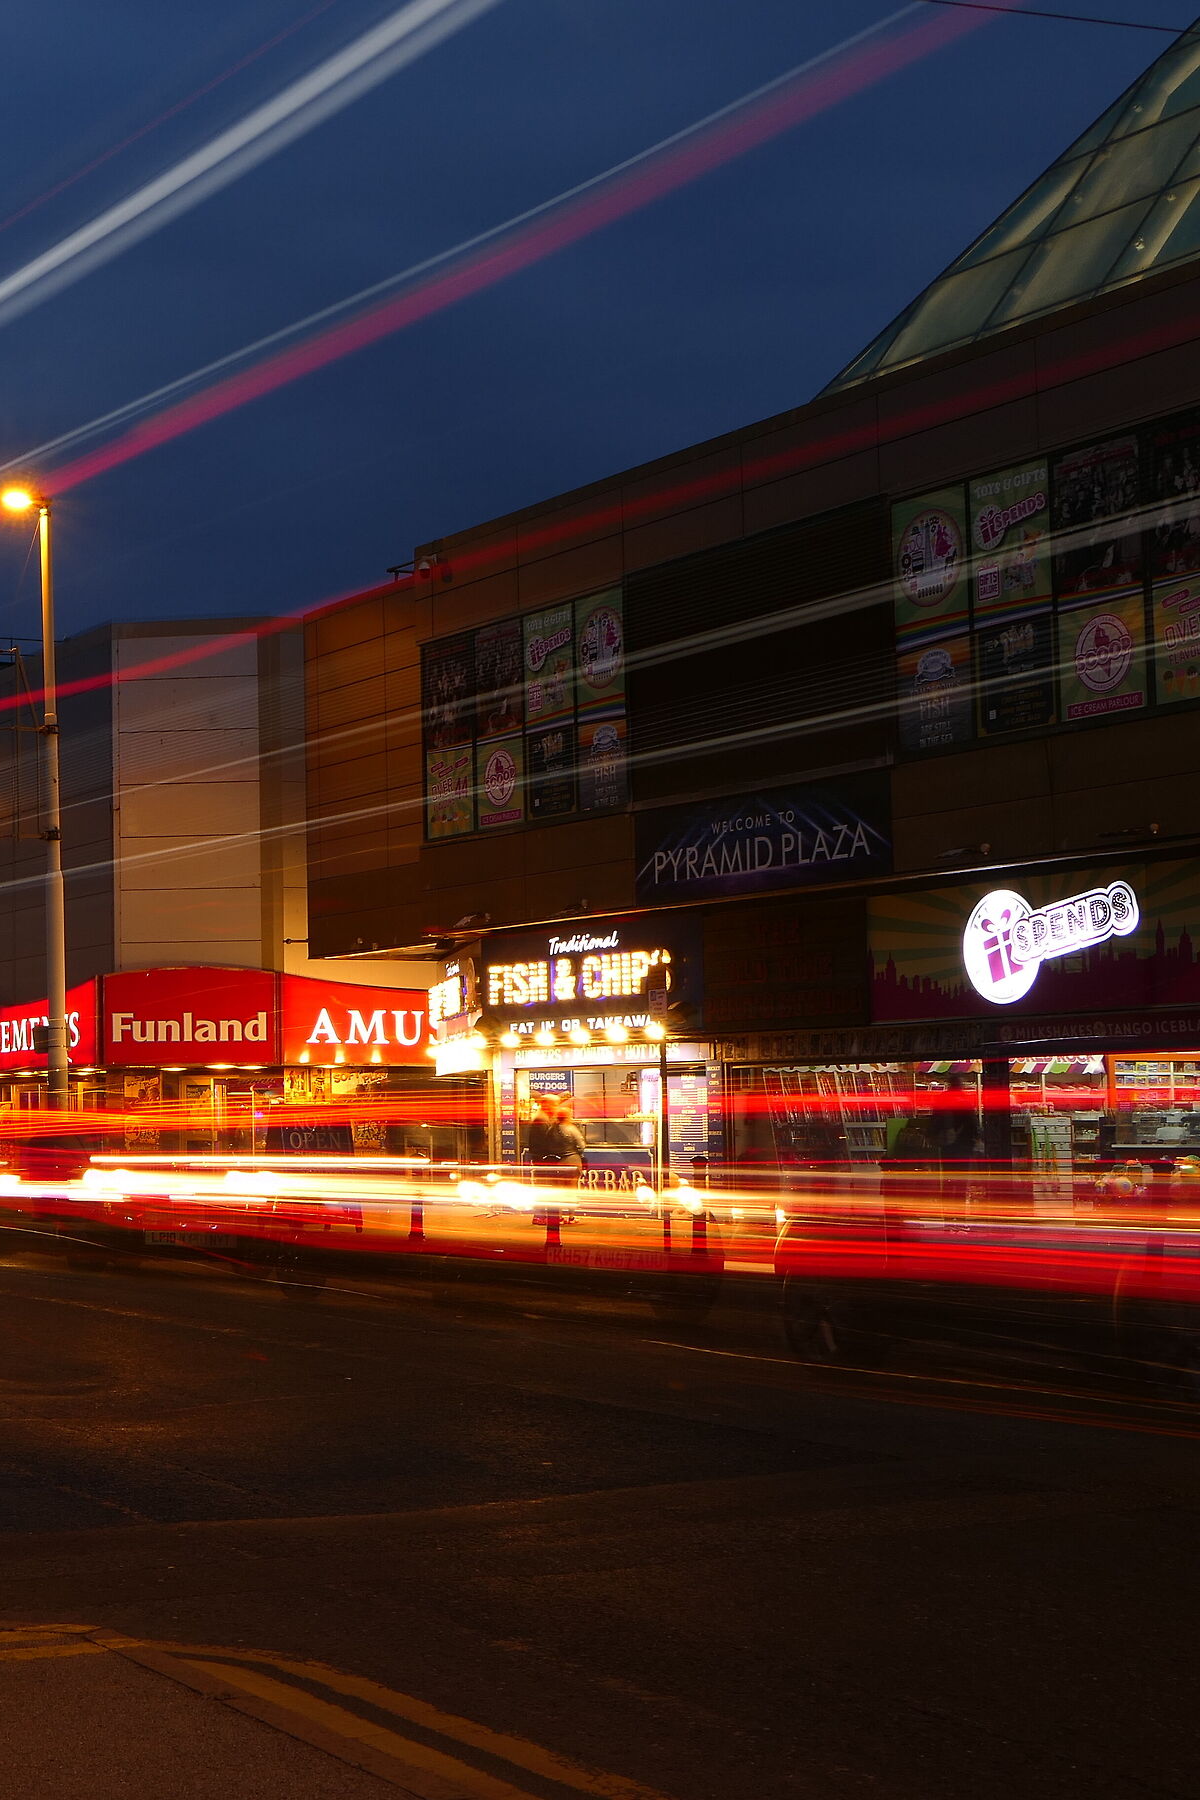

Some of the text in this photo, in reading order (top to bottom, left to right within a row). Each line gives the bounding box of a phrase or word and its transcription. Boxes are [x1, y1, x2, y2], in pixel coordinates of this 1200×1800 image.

[993, 492, 1047, 531] SPENDS
[1073, 634, 1133, 675] SCOOP
[711, 810, 795, 835] WELCOME TO
[654, 821, 871, 885] PYRAMID PLAZA
[1014, 889, 1132, 953] SPENDS
[548, 931, 619, 956] Traditional
[488, 961, 548, 1006] FISH
[553, 958, 576, 1001] &
[112, 1012, 267, 1043] Funland
[587, 1014, 660, 1031] TAKEAWA
[1015, 1023, 1093, 1039] MILKSHAKES
[1105, 1022, 1153, 1036] TANGO
[529, 1072, 566, 1081] BURGERS
[546, 1081, 568, 1090] DOGS
[289, 1131, 342, 1150] OPEN
